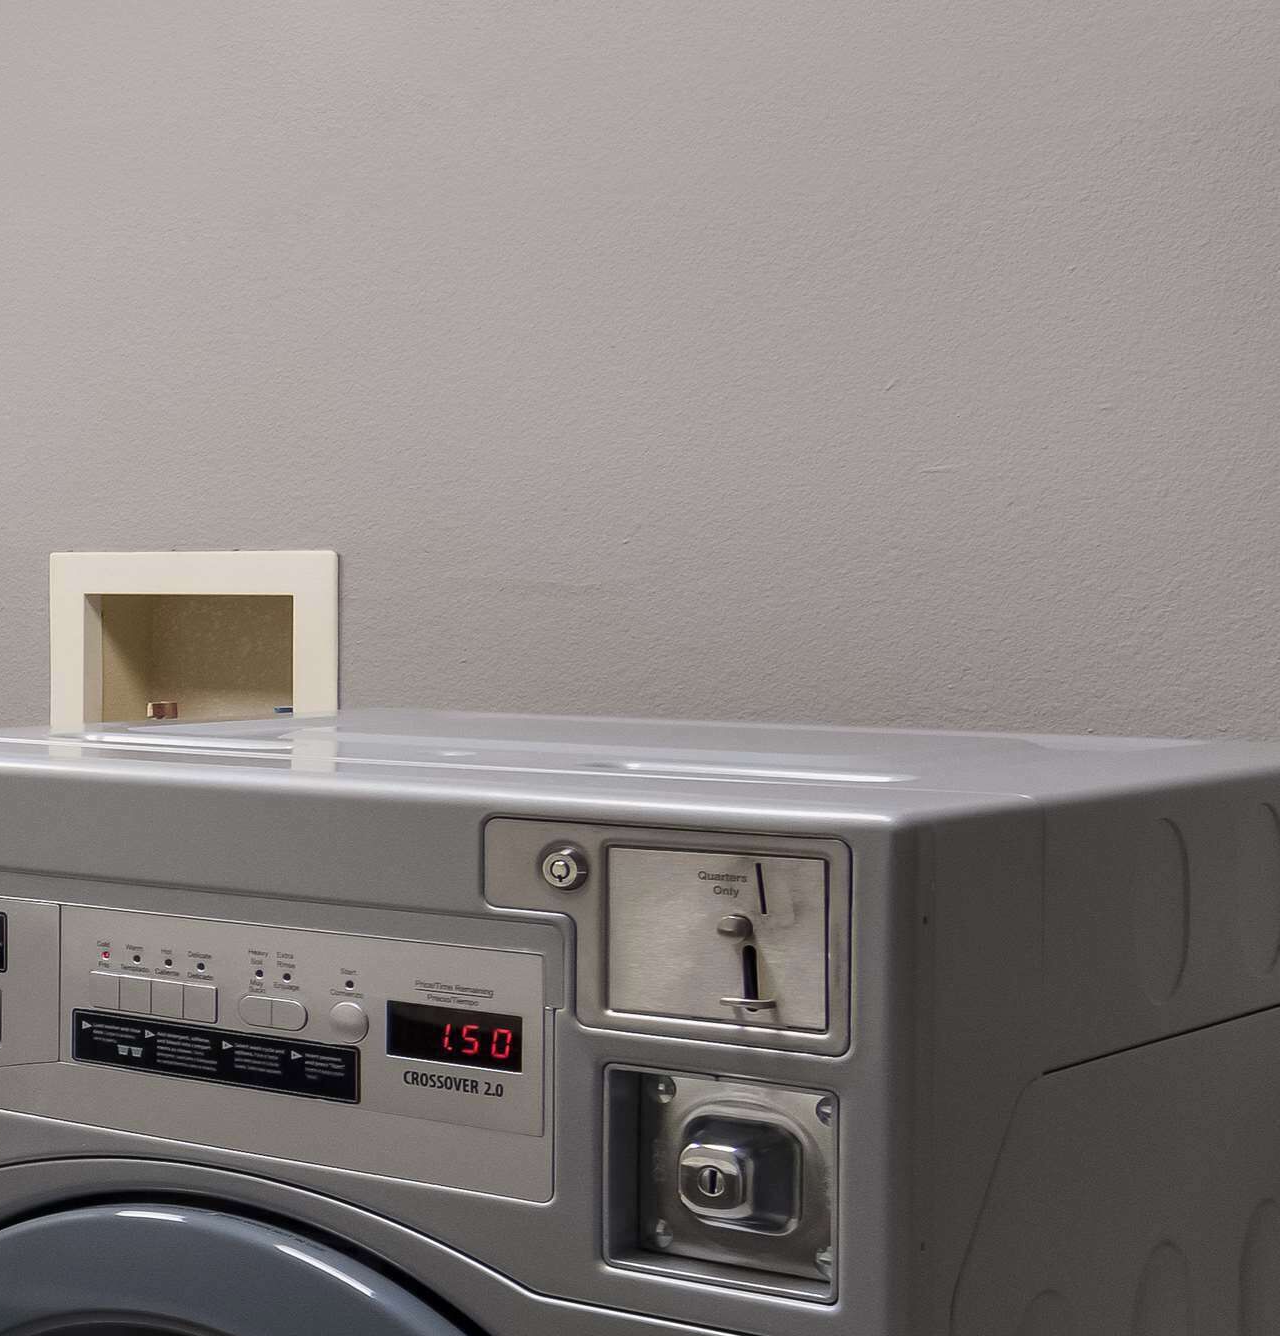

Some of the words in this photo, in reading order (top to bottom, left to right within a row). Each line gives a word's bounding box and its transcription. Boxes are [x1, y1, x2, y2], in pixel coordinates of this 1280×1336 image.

[698, 870, 748, 883] Quarters
[713, 885, 739, 898] Only
[188, 950, 212, 959] Delicate
[248, 949, 268, 958] Heavy
[276, 951, 294, 959] Extra
[276, 961, 296, 969] Rinse
[340, 968, 357, 976] Start
[415, 979, 453, 991] Price/Time
[454, 984, 494, 997] Remaining
[443, 1023, 513, 1059] 1.50
[403, 1070, 479, 1094] CROSSOVER
[484, 1082, 504, 1097] 2.0
